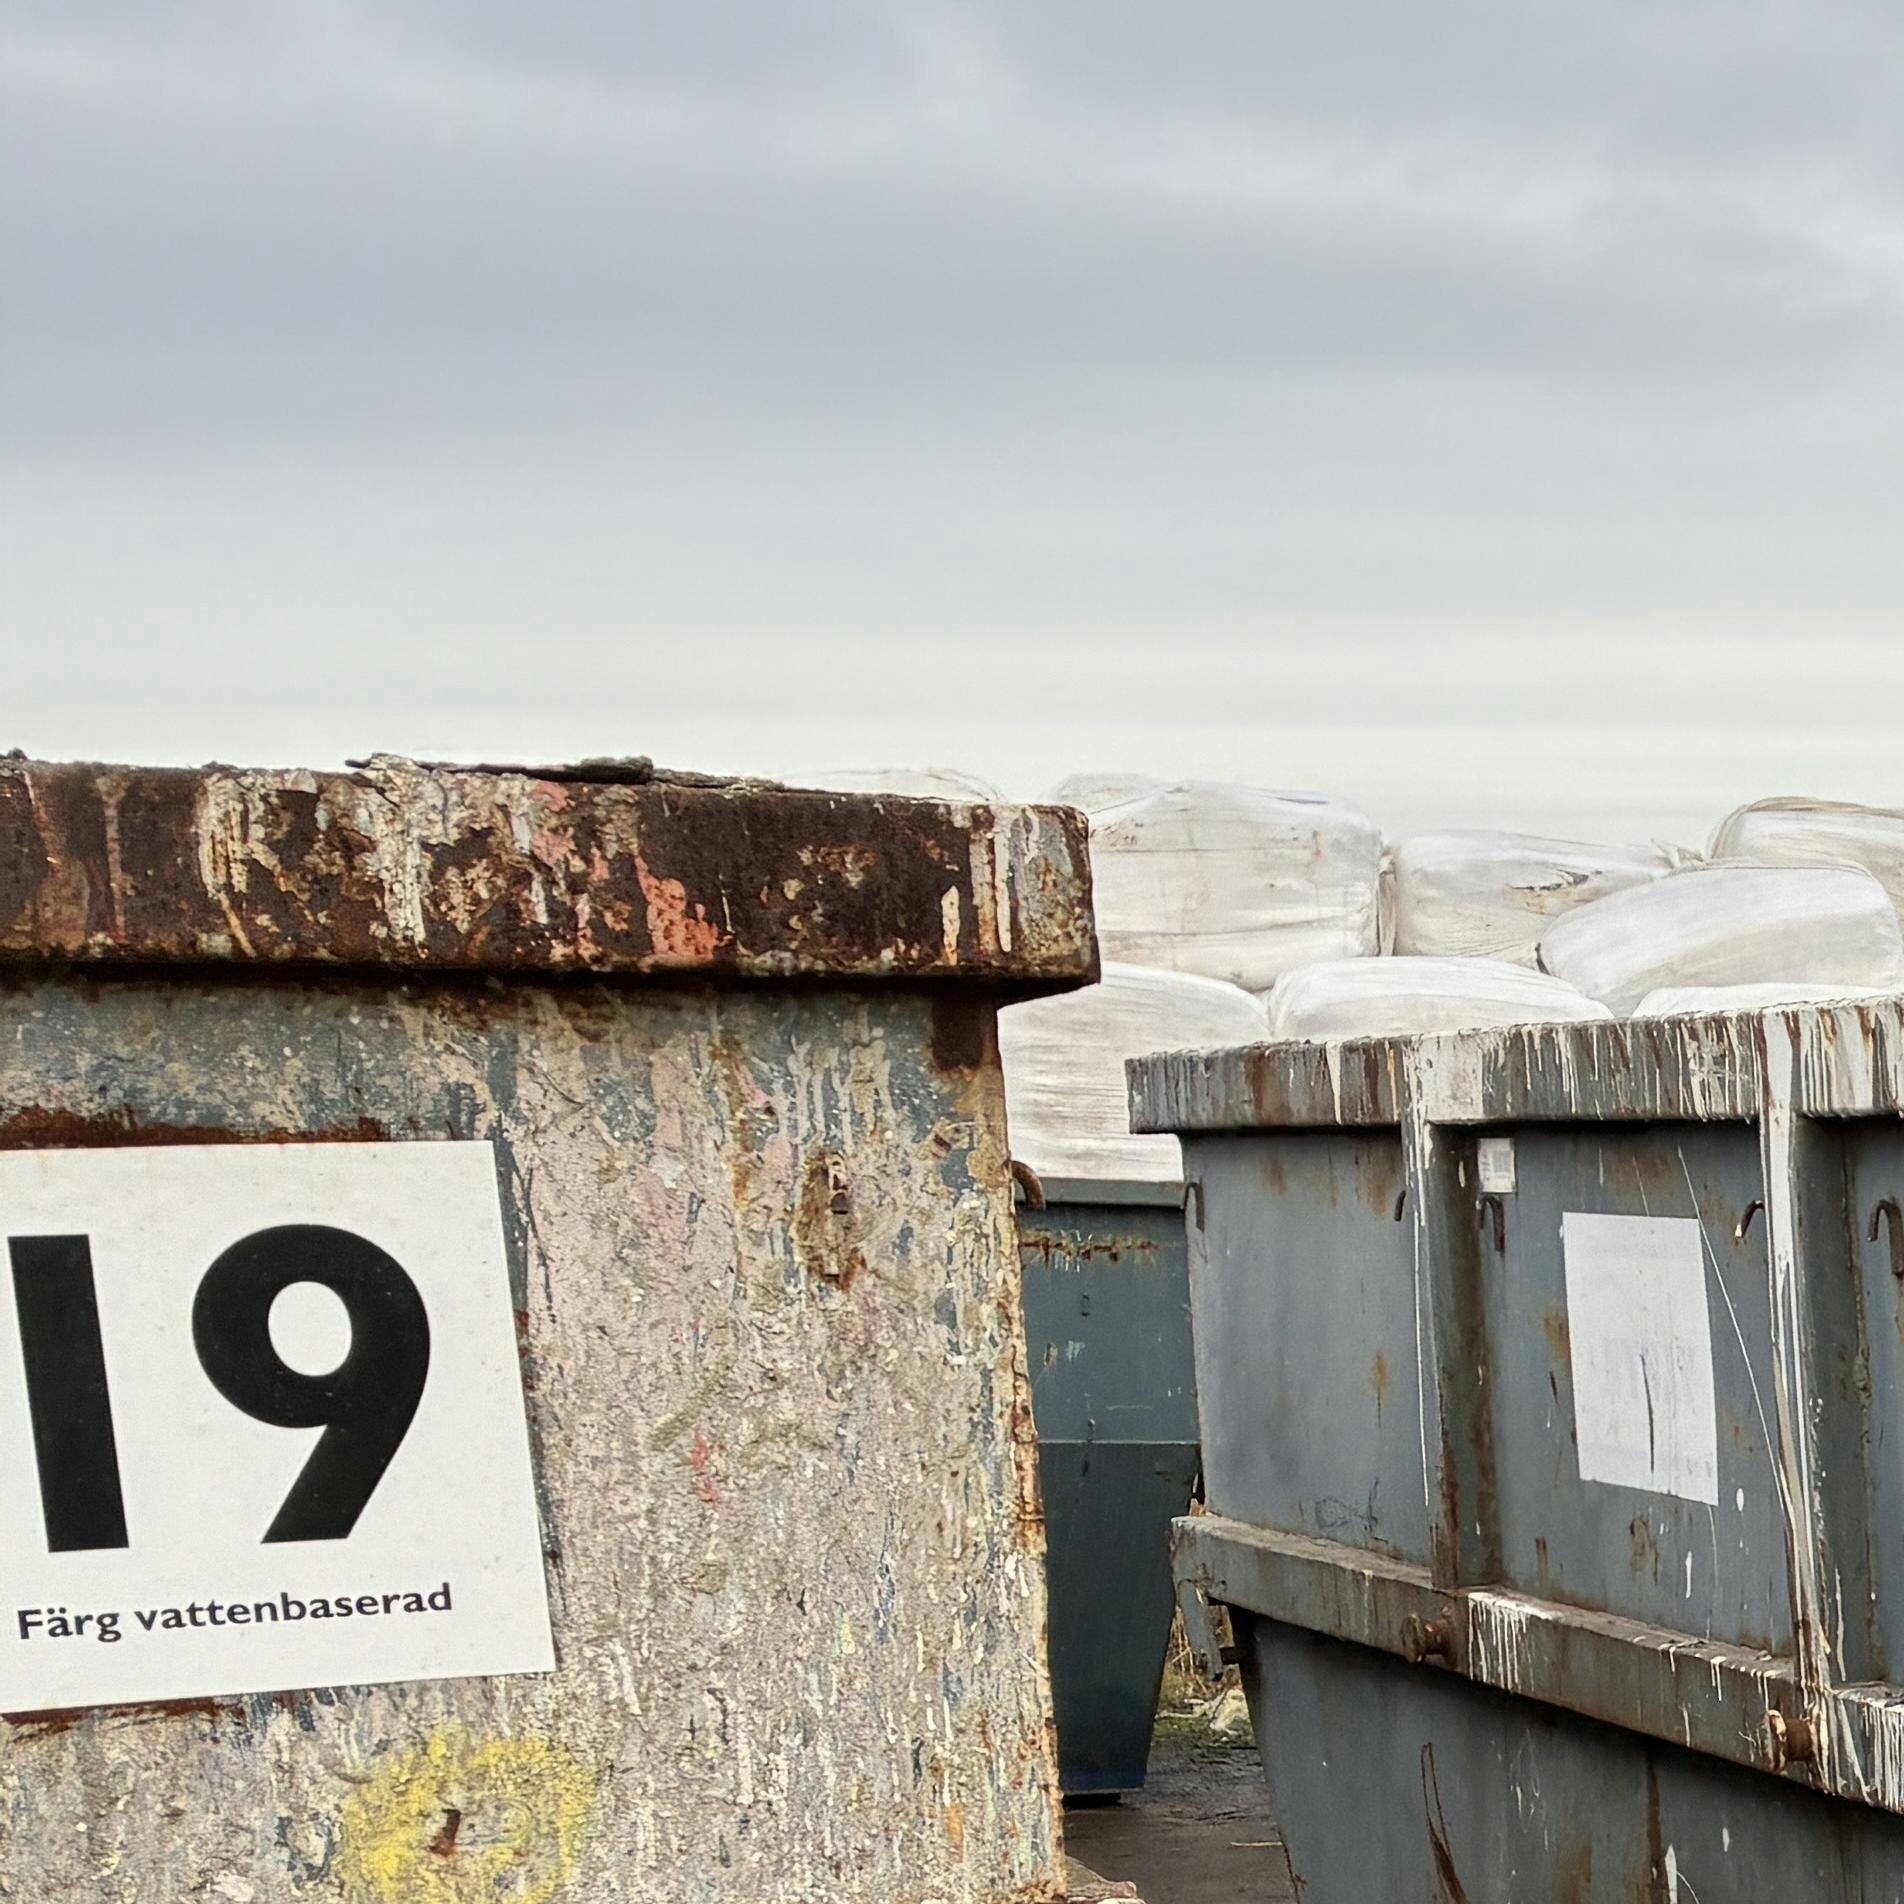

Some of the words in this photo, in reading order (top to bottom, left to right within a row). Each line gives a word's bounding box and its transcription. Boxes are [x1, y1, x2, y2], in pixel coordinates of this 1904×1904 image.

[7, 1223, 431, 1553] 19
[17, 1607, 122, 1643] Färg
[136, 1582, 453, 1632] vattenbaserad
